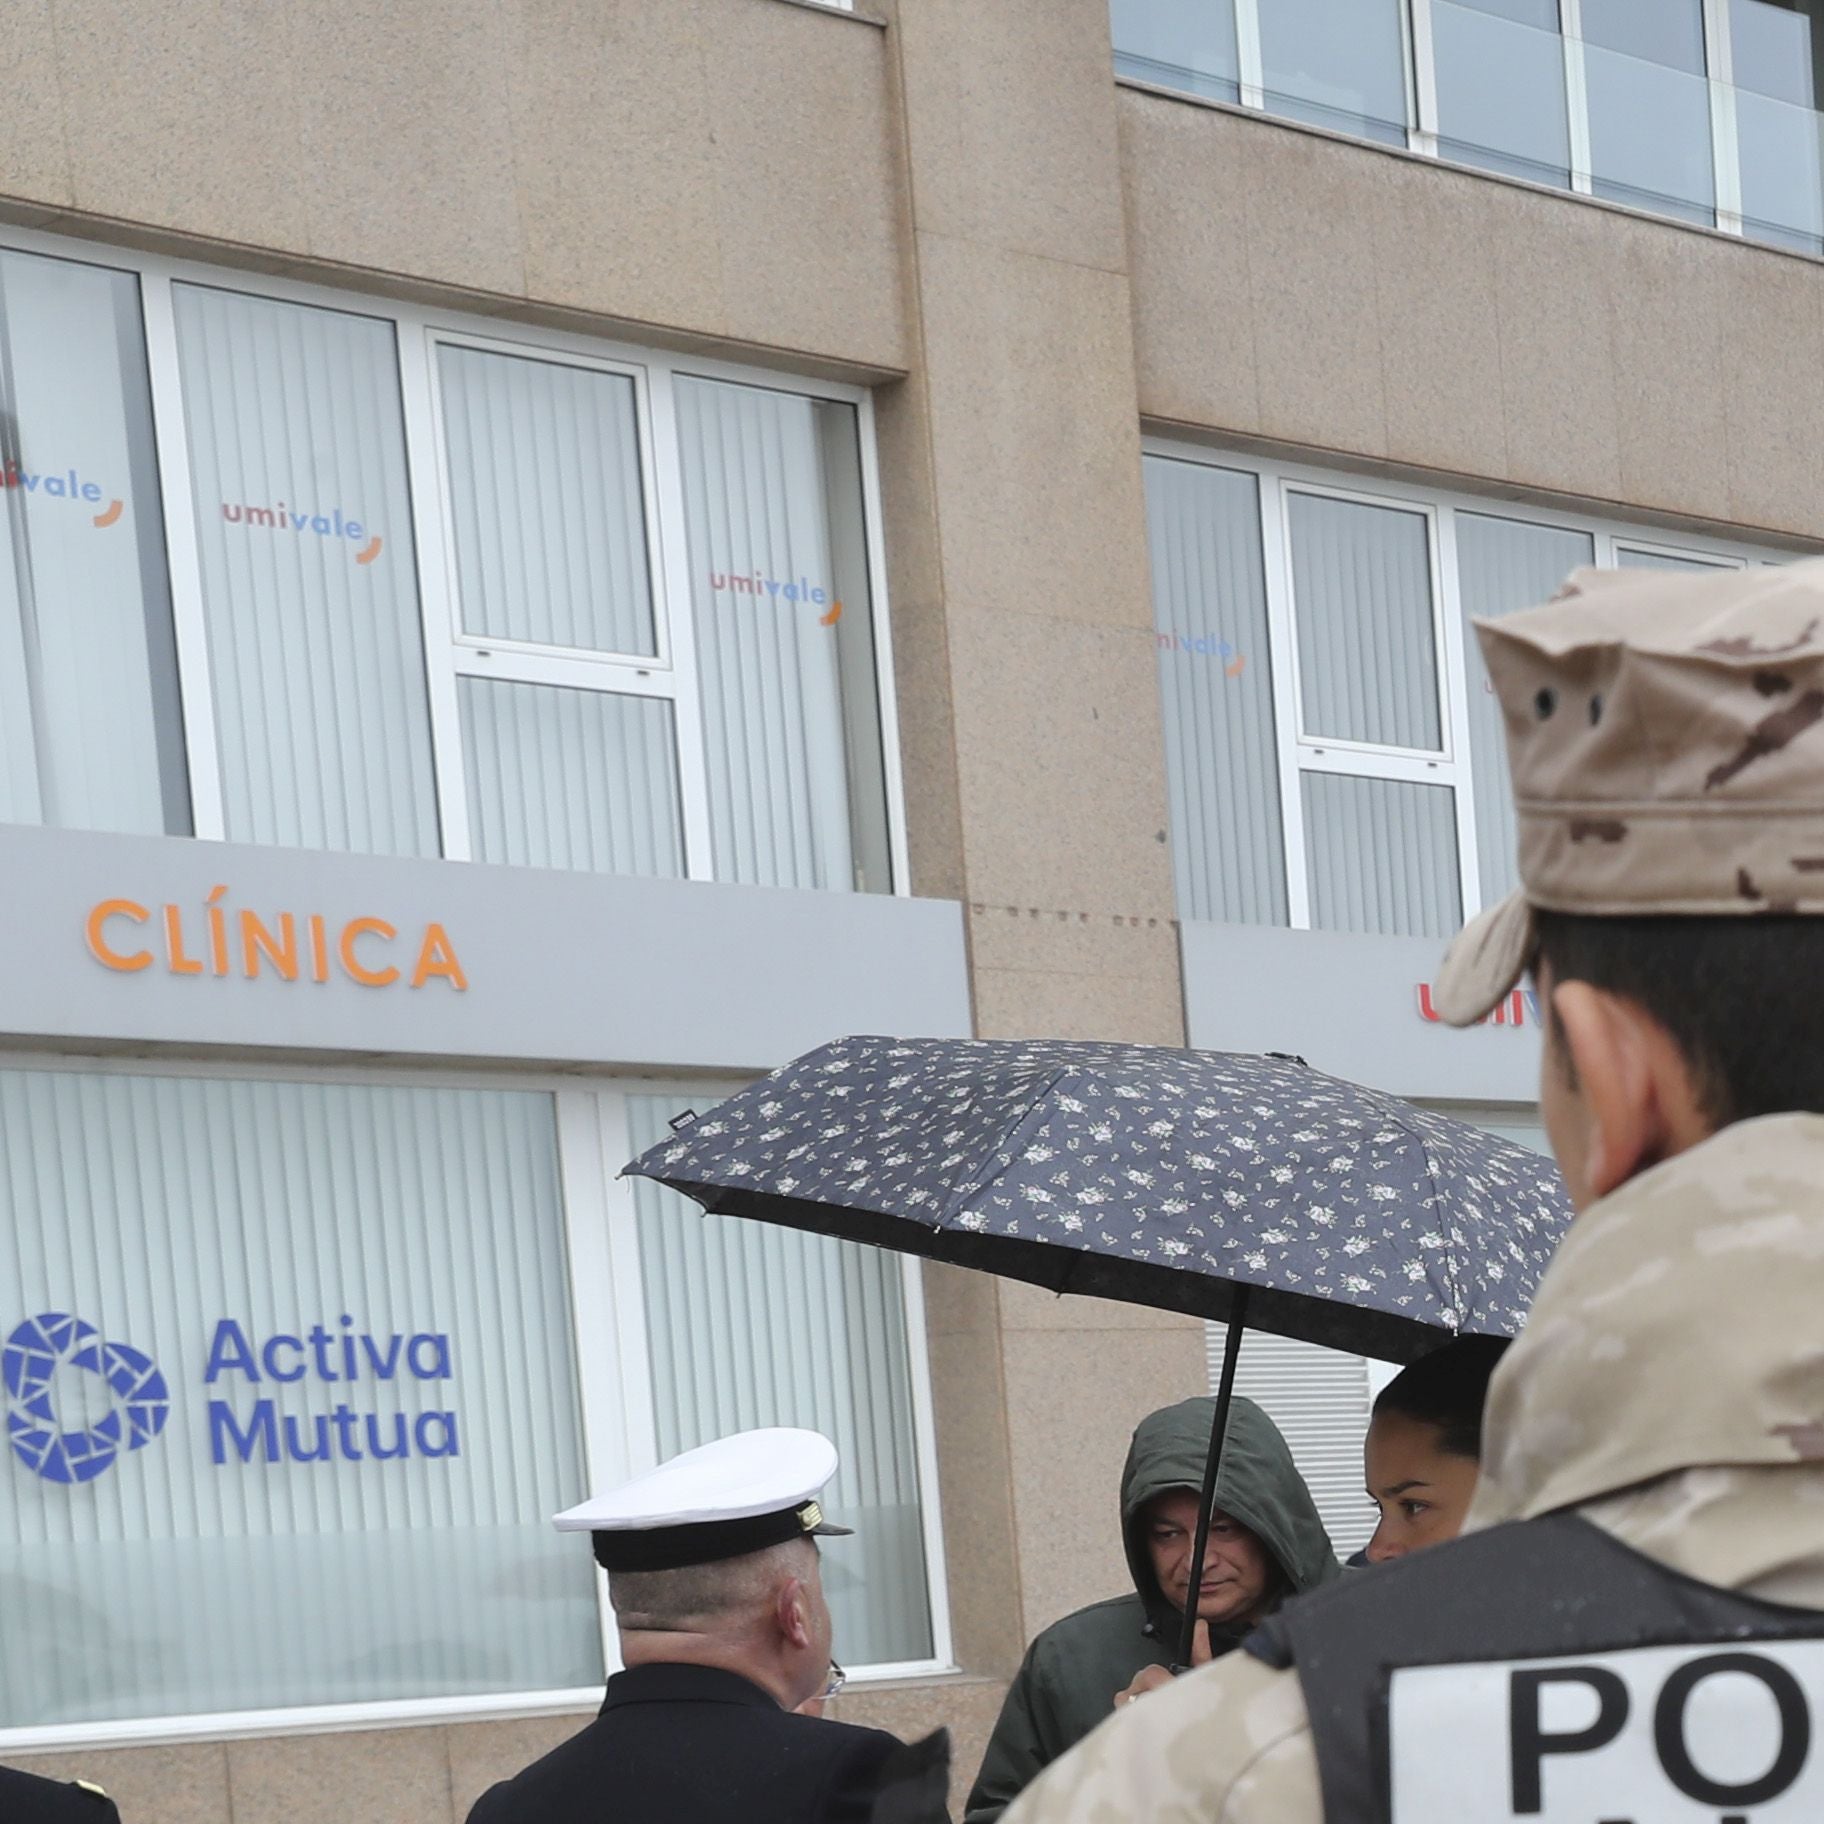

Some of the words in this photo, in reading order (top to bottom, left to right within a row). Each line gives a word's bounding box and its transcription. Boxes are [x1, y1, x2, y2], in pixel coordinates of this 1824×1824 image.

[222, 502, 363, 540] umivale
[710, 571, 826, 604] umivale
[86, 884, 470, 992] CLÍNICA
[203, 1314, 453, 1384] Activa
[206, 1398, 460, 1465] Mutua
